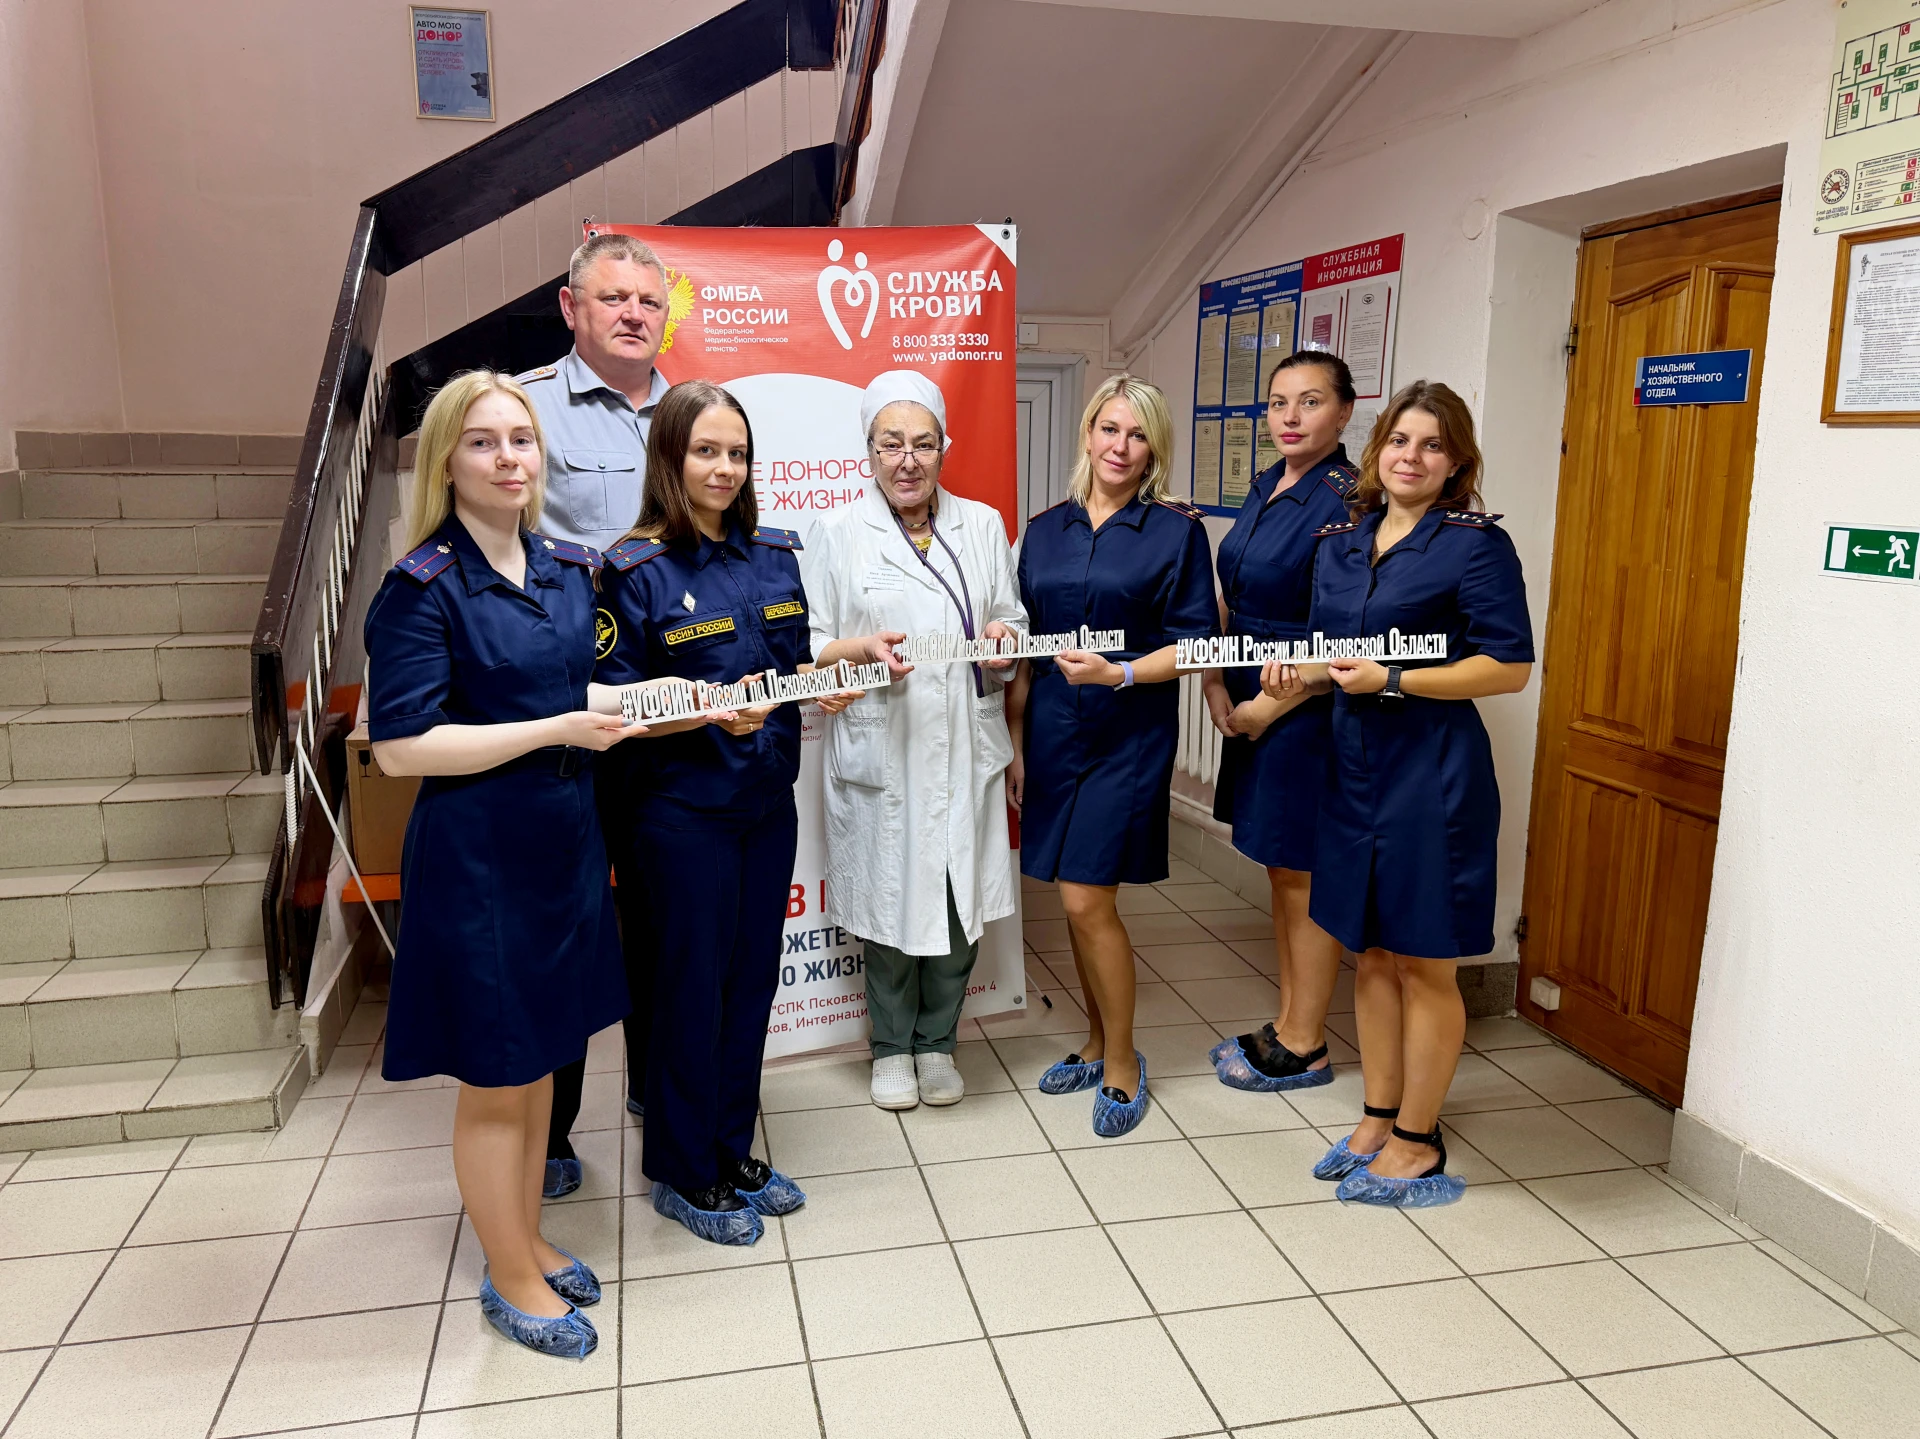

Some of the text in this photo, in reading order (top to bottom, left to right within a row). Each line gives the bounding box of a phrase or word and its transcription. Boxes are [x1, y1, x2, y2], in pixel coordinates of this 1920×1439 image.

[438, 22, 462, 30] МОТО
[417, 29, 462, 41] ДОНОР
[1322, 243, 1380, 268] СЛУЖЕБНАЯ
[1265, 262, 1302, 278] ЗДРАВООХРАНЕНИЯ
[1317, 258, 1383, 284] ИНФОРМАЦИЯ
[887, 269, 1003, 294] СЛУЖБА
[701, 285, 764, 302] ФМБА
[889, 294, 982, 319] КРОВИ
[703, 308, 789, 325] РОССИИ
[704, 327, 754, 335] Федеральное
[892, 333, 989, 348] 8 800 333 3330
[1648, 362, 1696, 374] НАЧАЛЬНИК
[1647, 373, 1723, 386] ХОЗЯЙСТВЕННОГО
[1646, 388, 1676, 398] ОТДЕЛА
[668, 620, 732, 642] ФСИН РОССИИ
[1176, 635, 1239, 665] #УФСИН
[620, 682, 696, 721] #УФСИН
[780, 926, 847, 955] ЖЕТЕ
[990, 981, 997, 991] 4
